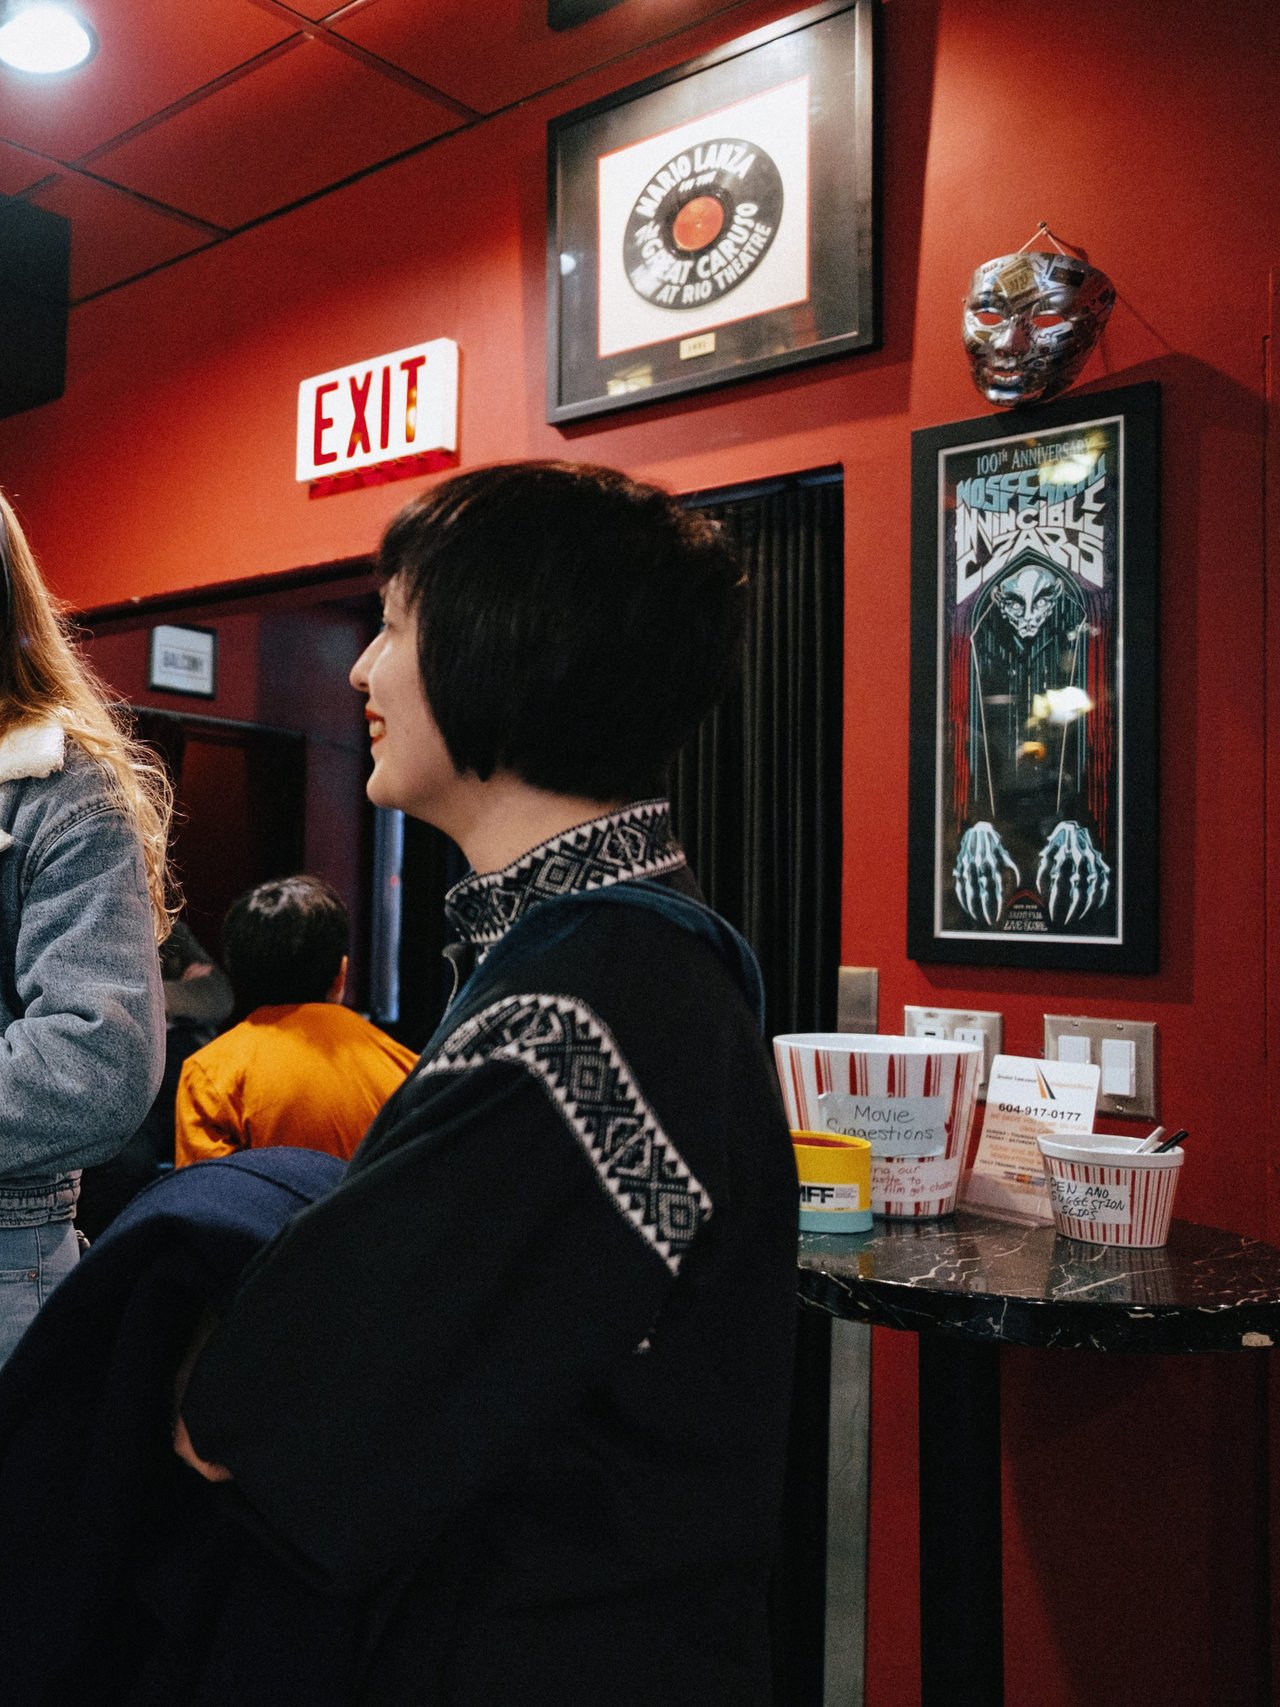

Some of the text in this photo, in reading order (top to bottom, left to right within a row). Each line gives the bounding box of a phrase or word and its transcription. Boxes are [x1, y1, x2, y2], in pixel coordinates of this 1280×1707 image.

[635, 143, 757, 218] MARIO LANZA
[641, 238, 694, 286] GREAT
[696, 202, 759, 280] CARUSO
[655, 283, 681, 305] AT
[681, 281, 713, 304] RIO
[713, 221, 772, 291] THEATRE
[313, 354, 427, 467] EXIT
[955, 476, 1106, 555] INVINCIBLE
[956, 527, 1104, 606] CZARS
[826, 1117, 934, 1141] Suggestions
[853, 1104, 915, 1124] Movie
[999, 1102, 1082, 1122] 604-917-0177
[1050, 1190, 1126, 1211] SUGGESTION
[1061, 1204, 1099, 1221] SLIPS
[1085, 1186, 1109, 1199] AND
